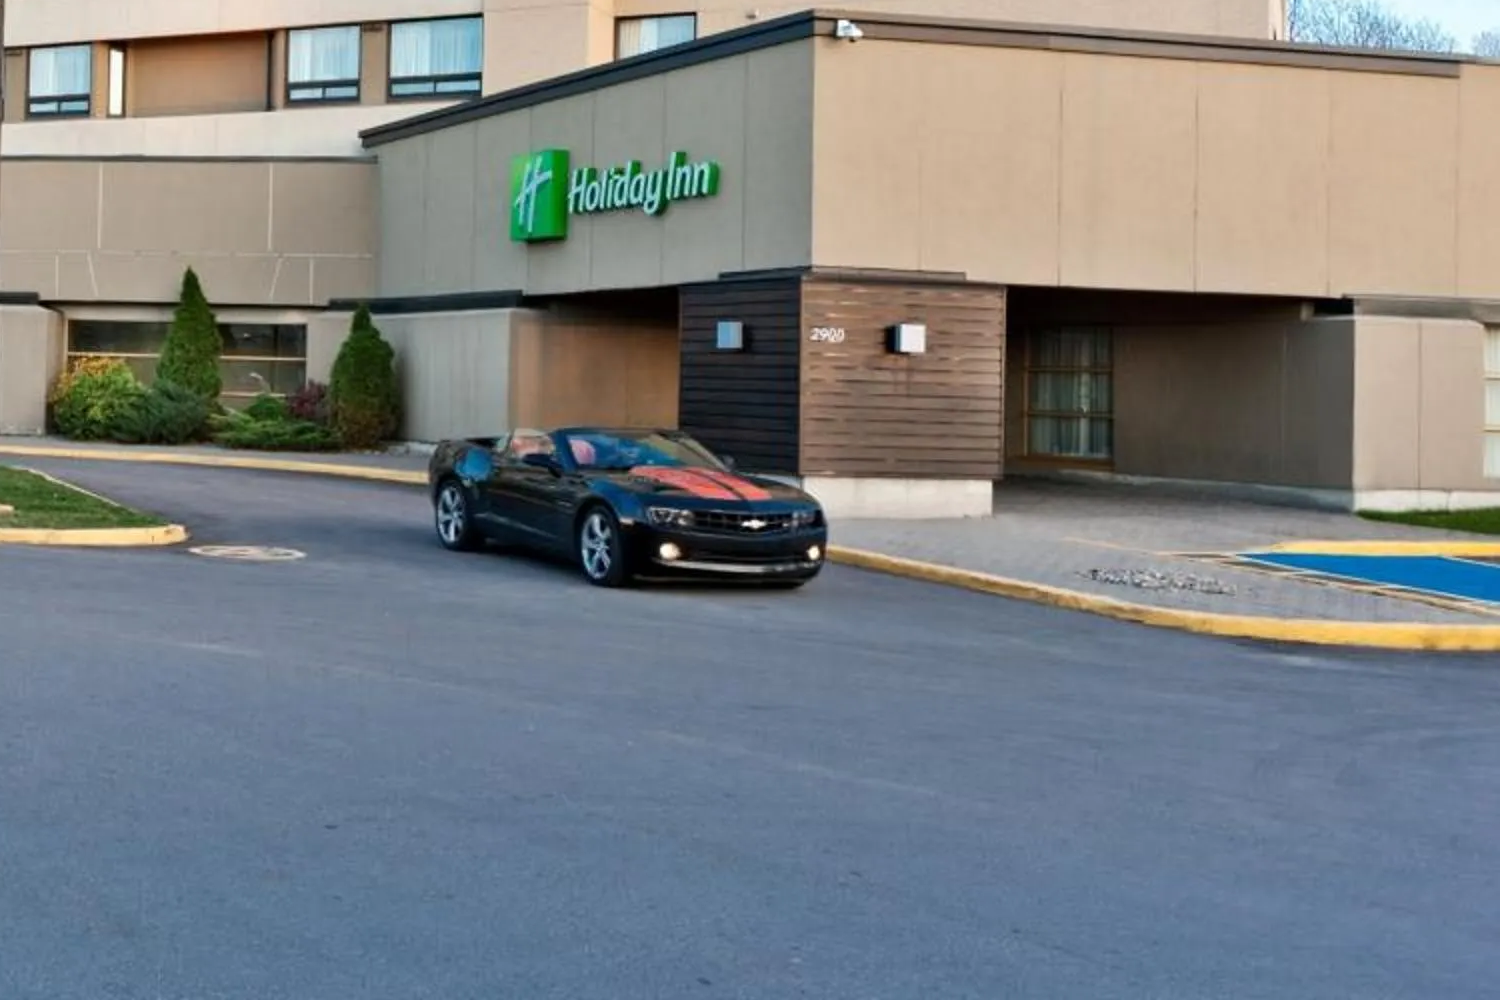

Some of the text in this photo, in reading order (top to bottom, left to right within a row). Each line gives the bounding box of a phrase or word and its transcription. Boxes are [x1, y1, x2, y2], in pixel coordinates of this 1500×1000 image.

[567, 151, 713, 215] Holiday Inn
[810, 326, 845, 343] 2900
